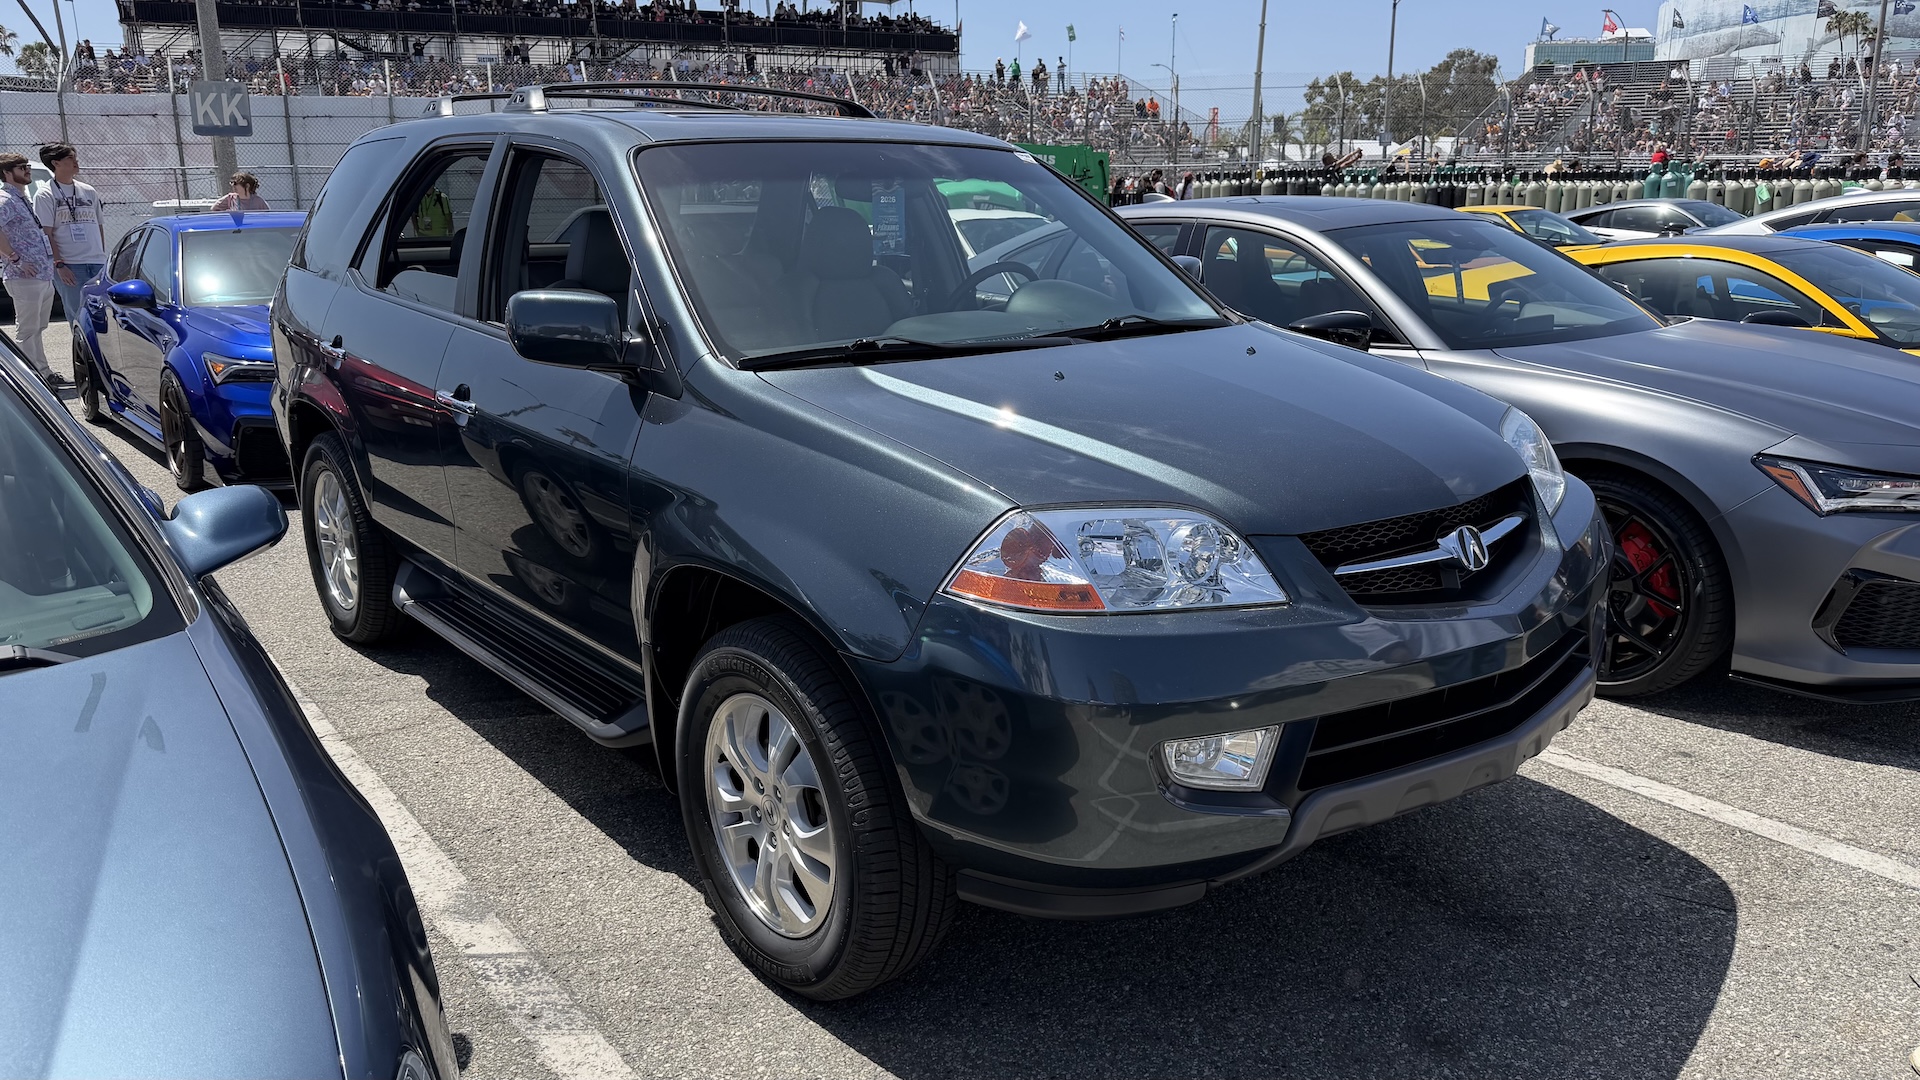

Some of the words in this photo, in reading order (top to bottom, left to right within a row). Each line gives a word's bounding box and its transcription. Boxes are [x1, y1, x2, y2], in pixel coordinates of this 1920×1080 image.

[195, 92, 248, 127] KK
[719, 659, 769, 687] MICHELIN
[741, 941, 792, 979] MICHELIN
